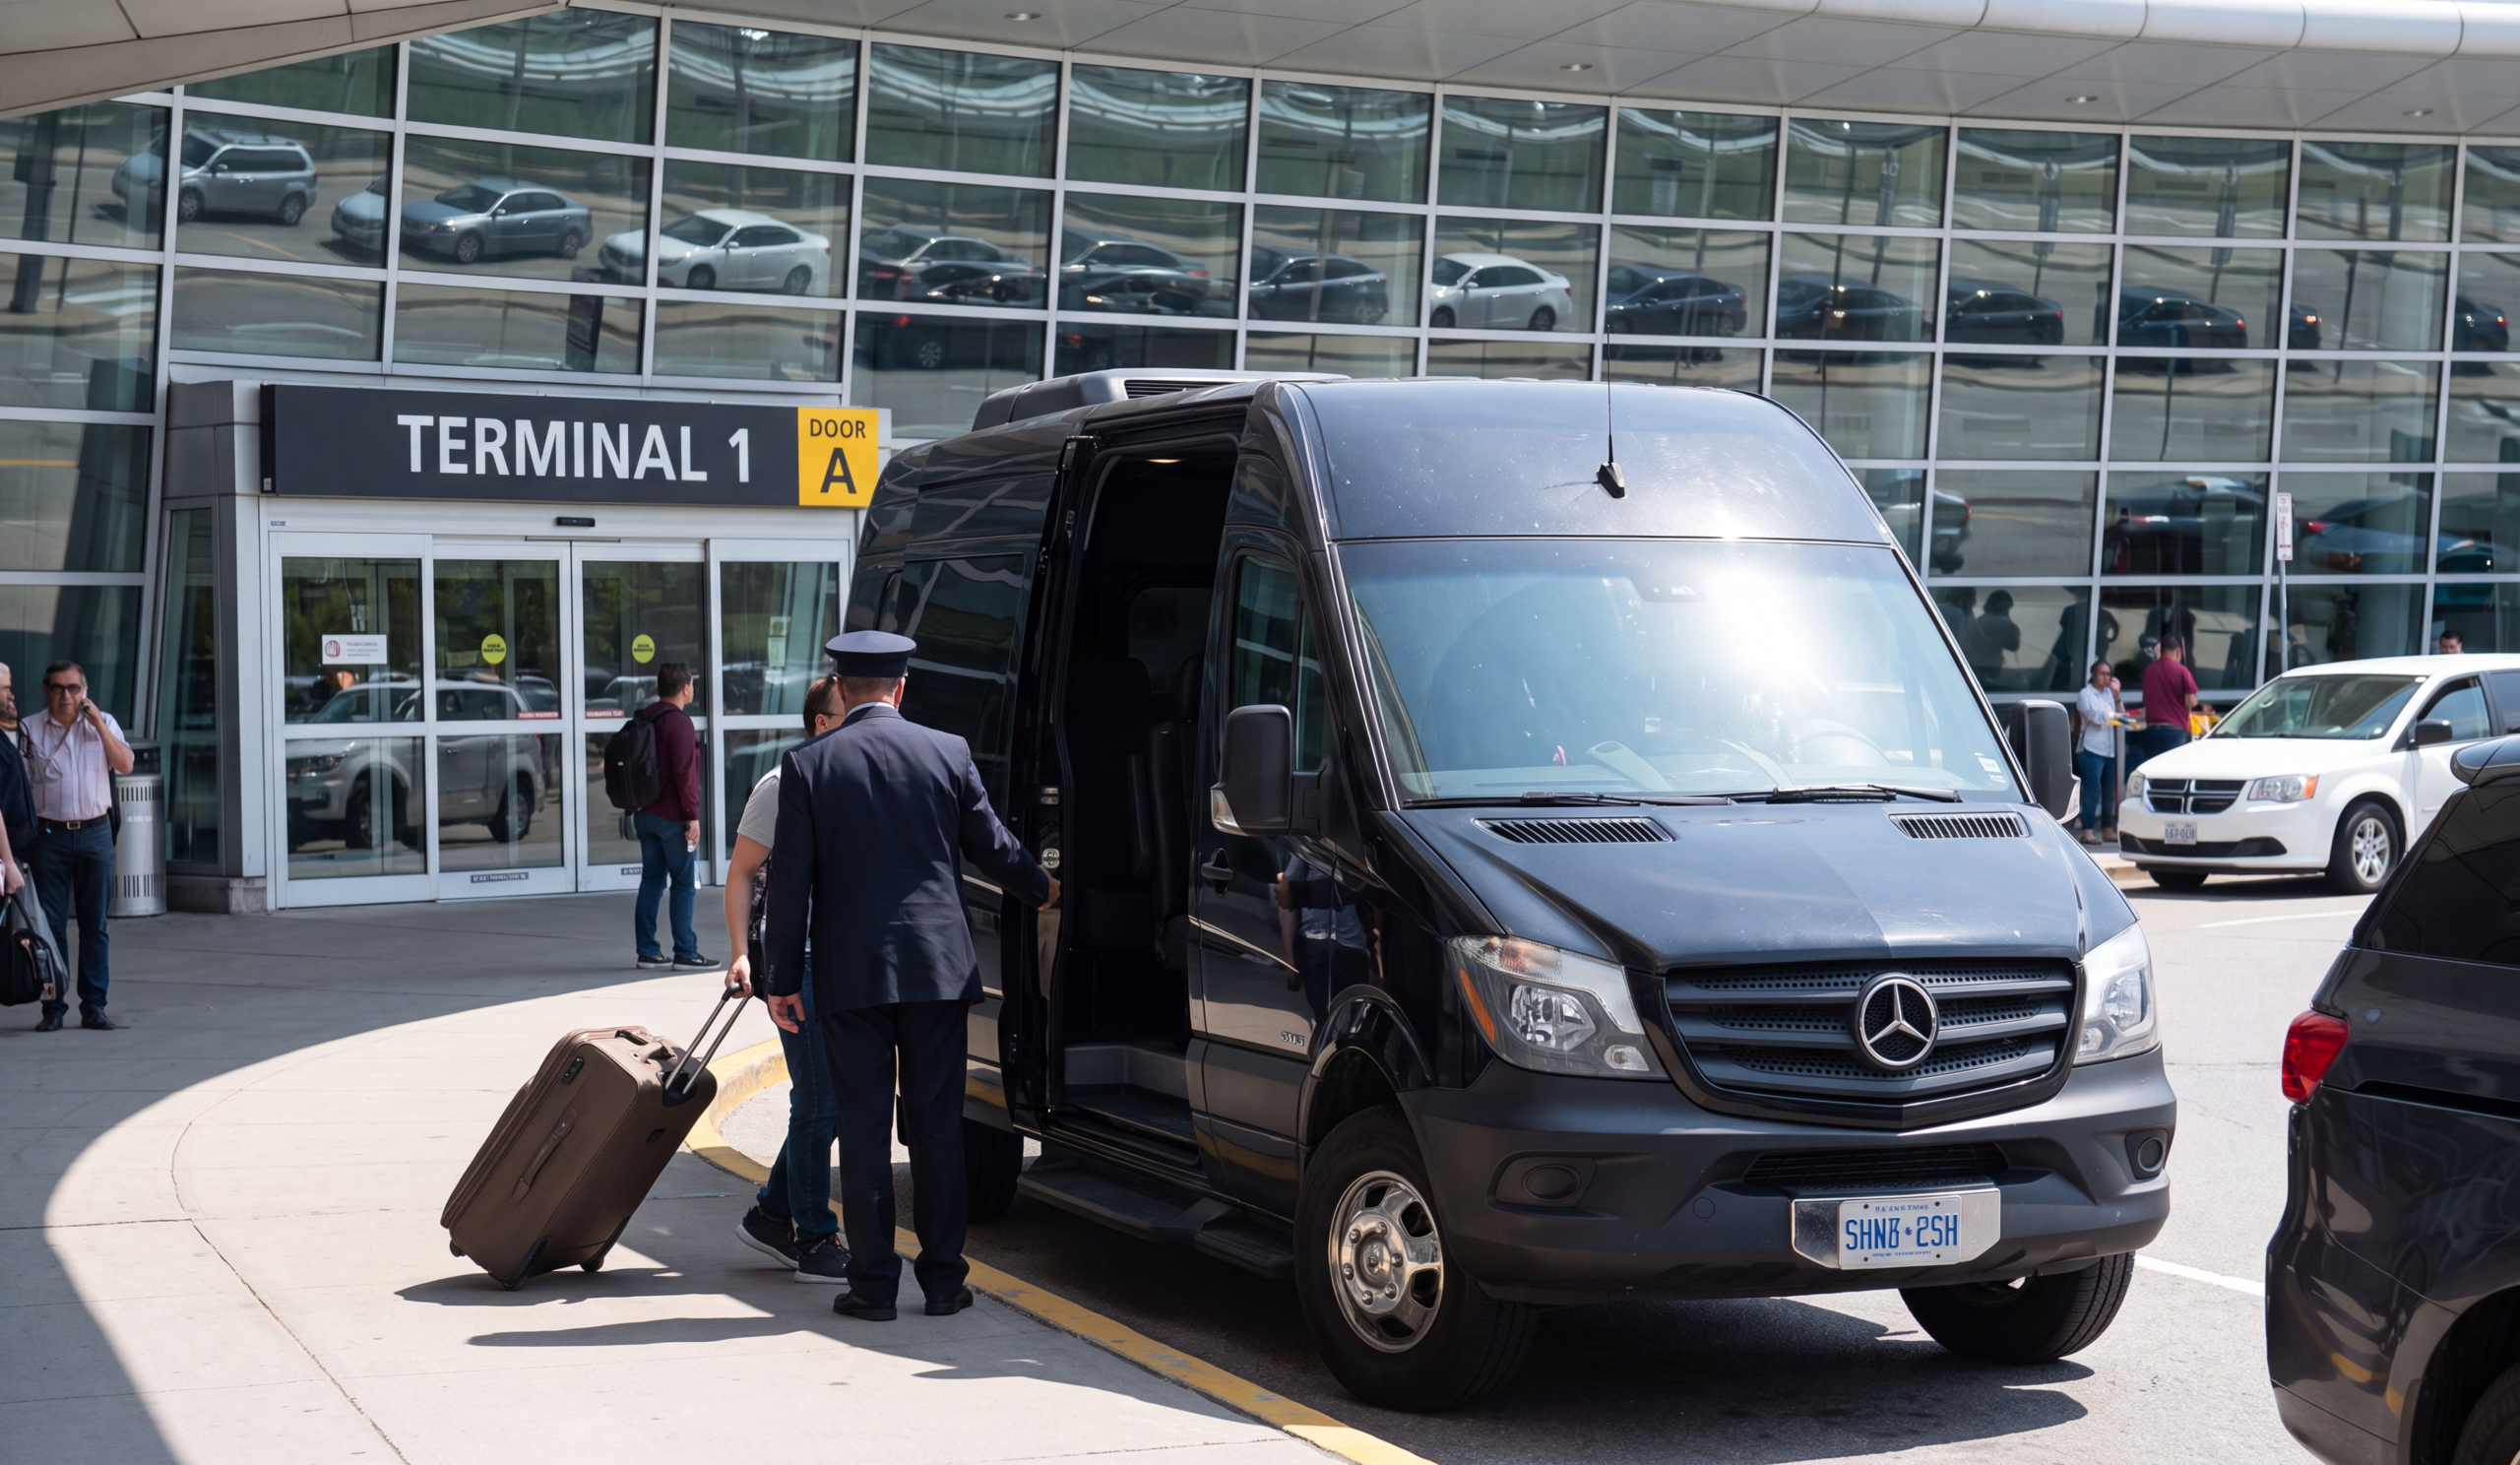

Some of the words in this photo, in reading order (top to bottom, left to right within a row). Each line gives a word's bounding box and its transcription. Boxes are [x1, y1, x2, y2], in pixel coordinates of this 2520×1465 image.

[397, 414, 708, 481] TERMINAL
[727, 427, 749, 483] 1
[809, 418, 866, 439] DOOR
[820, 447, 857, 494] A
